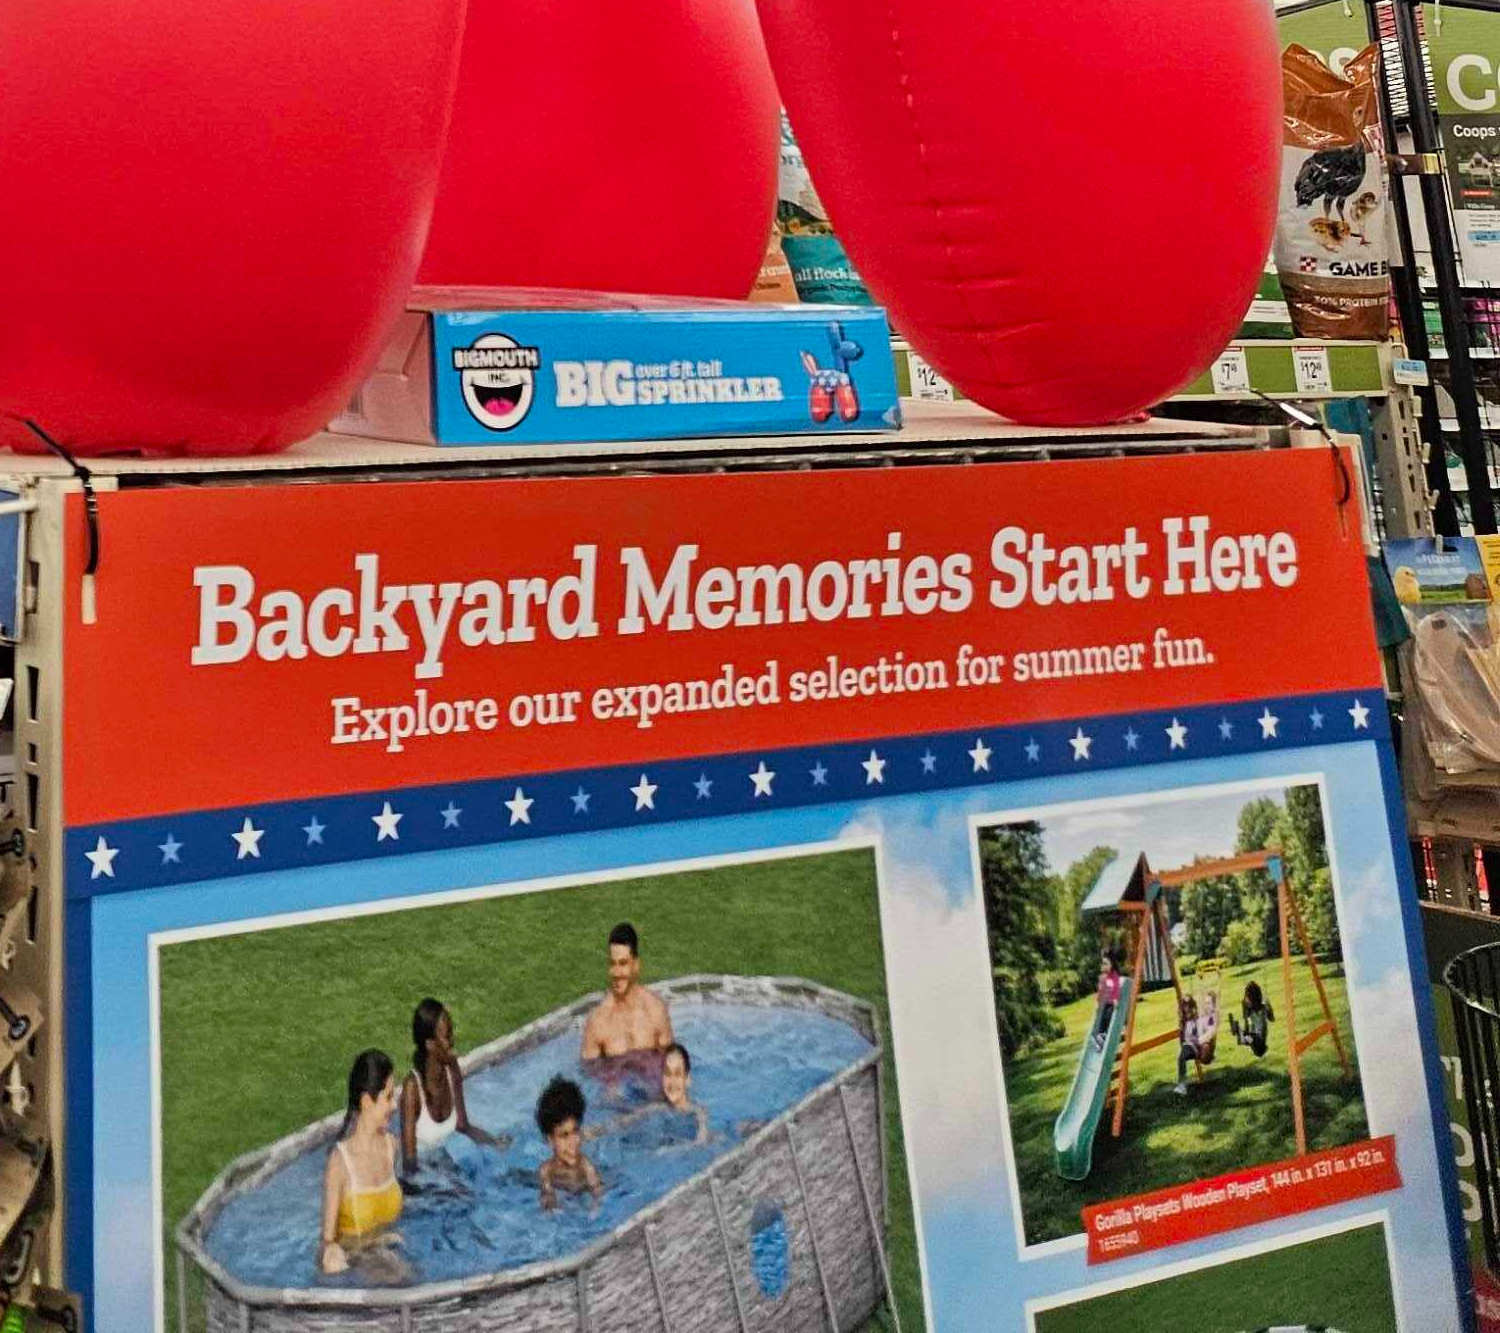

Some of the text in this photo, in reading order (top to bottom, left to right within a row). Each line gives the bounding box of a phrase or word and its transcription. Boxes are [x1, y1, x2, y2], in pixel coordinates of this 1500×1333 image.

[1452, 124, 1496, 149] Coops
[1328, 261, 1377, 276] GAME
[1339, 297, 1378, 309] PROTEIN
[454, 348, 538, 370] BIGMOUTH
[554, 359, 637, 408] BIG
[637, 378, 784, 405] SPRINKLER
[192, 515, 1298, 679] Backyard Memories Start Here
[331, 627, 1214, 753] Explore our expanded selection for summer fun.
[1095, 1207, 1133, 1232] Gorilla
[1134, 1198, 1181, 1223] Playsets
[1181, 1187, 1226, 1211] Wooden
[1270, 1170, 1290, 1187] 144
[1357, 1151, 1372, 1167] 92
